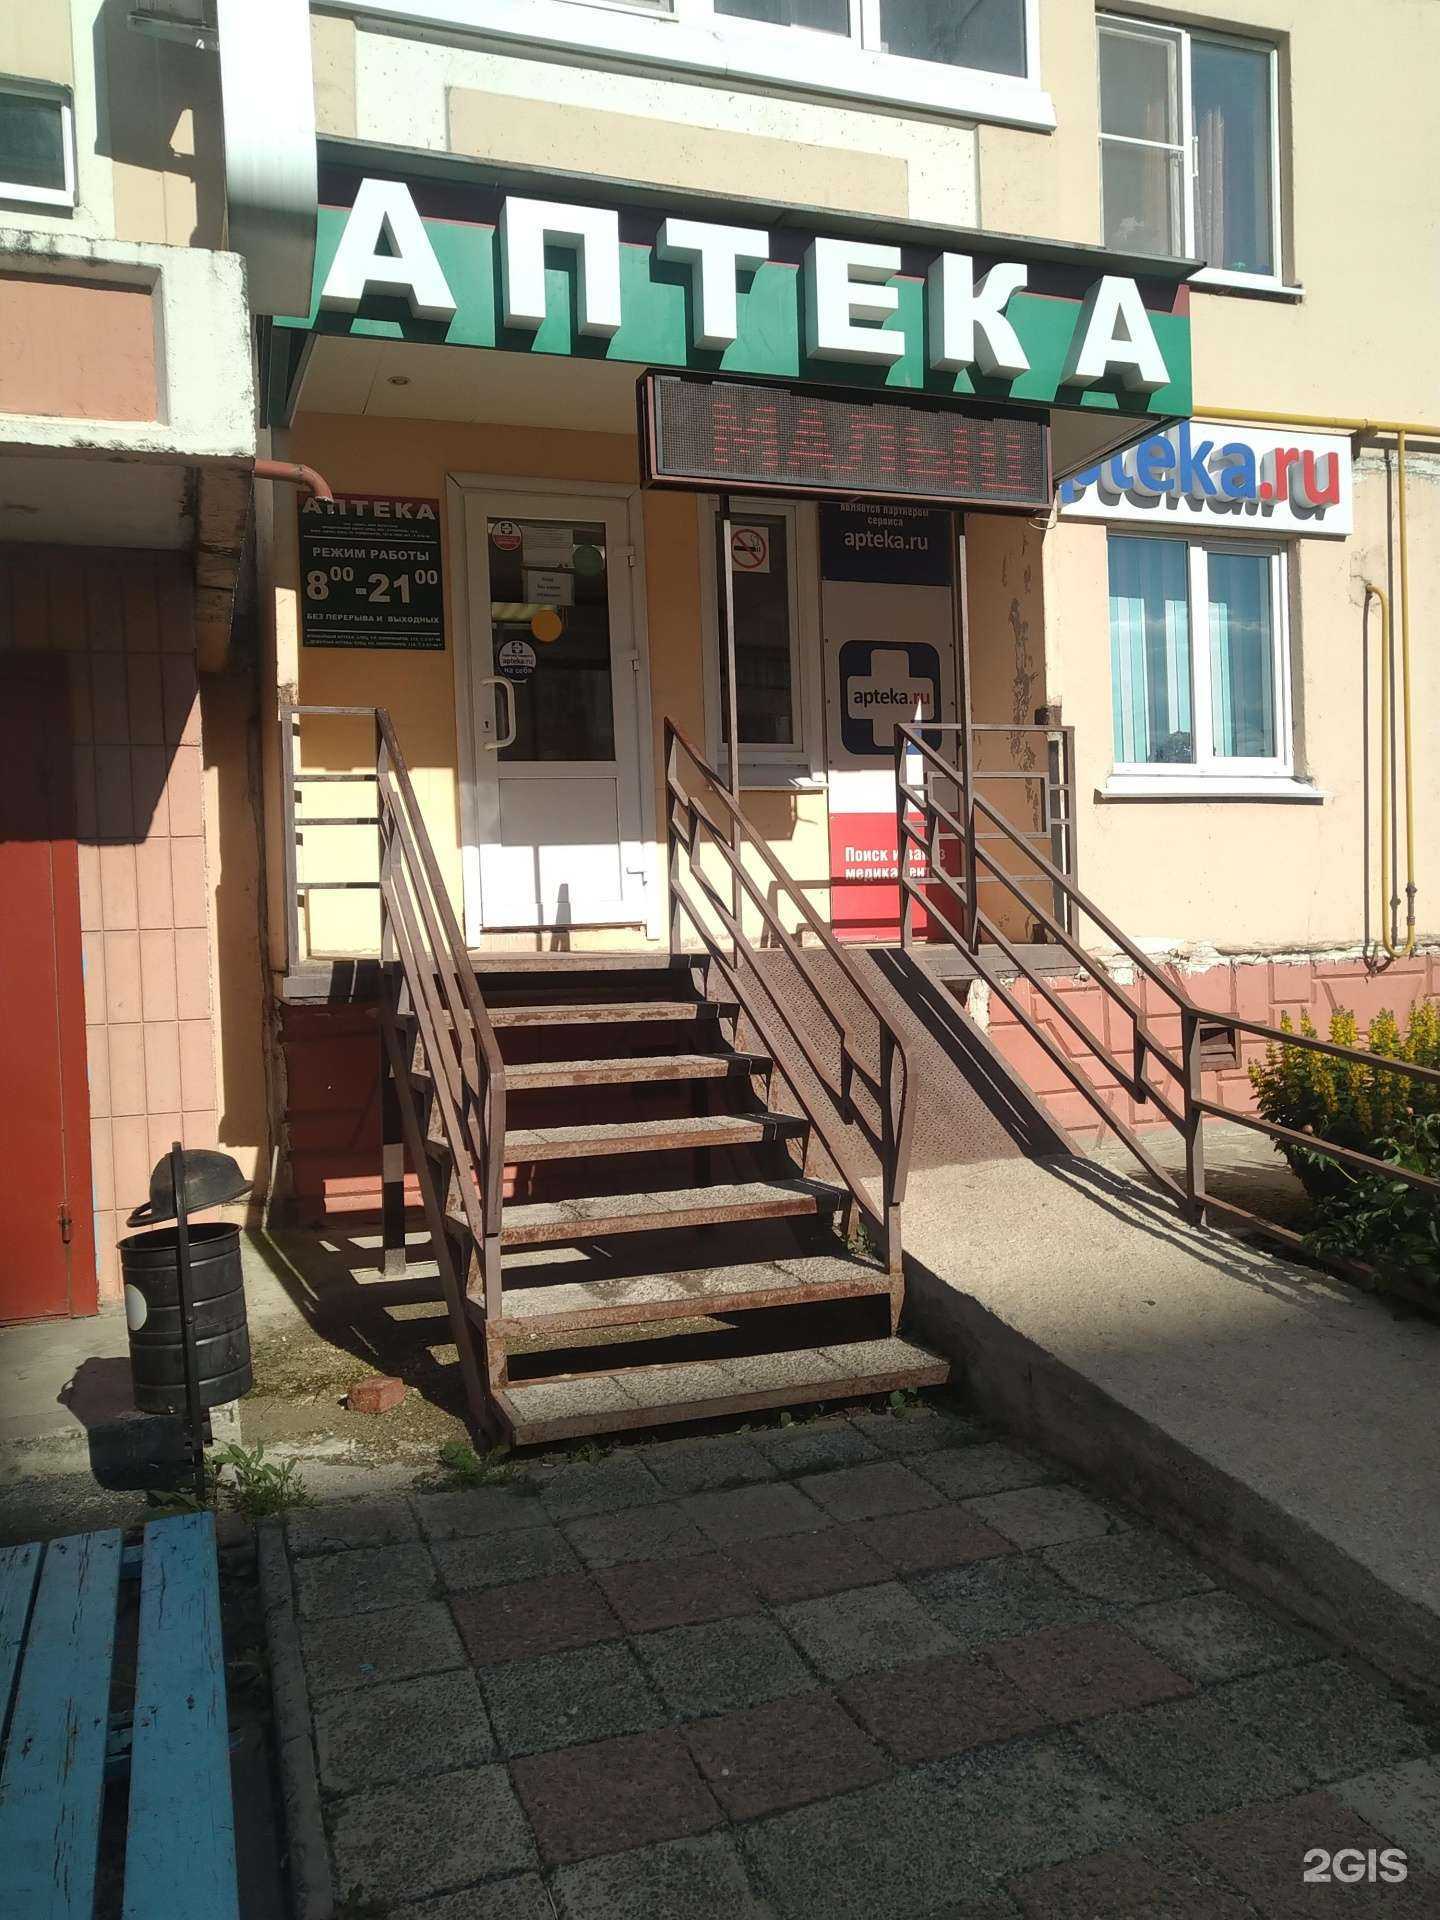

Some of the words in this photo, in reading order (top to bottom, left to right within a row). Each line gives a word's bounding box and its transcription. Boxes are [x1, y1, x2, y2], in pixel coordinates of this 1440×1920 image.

[320, 177, 1171, 394] АПТЕКА
[1061, 419, 1340, 505] teka.ru
[303, 497, 436, 520] АПТЕКА
[867, 517, 904, 528] сервиса
[844, 529, 929, 551] apteka.ru
[313, 547, 366, 558] РЕЖИМ
[370, 549, 430, 560] РАБОТЫ
[326, 613, 375, 622] ПЕРЕРЫВА
[387, 616, 440, 624] ВЫХОДНЫХ
[853, 687, 930, 708] apteka.ru
[845, 846, 888, 863] Поиск
